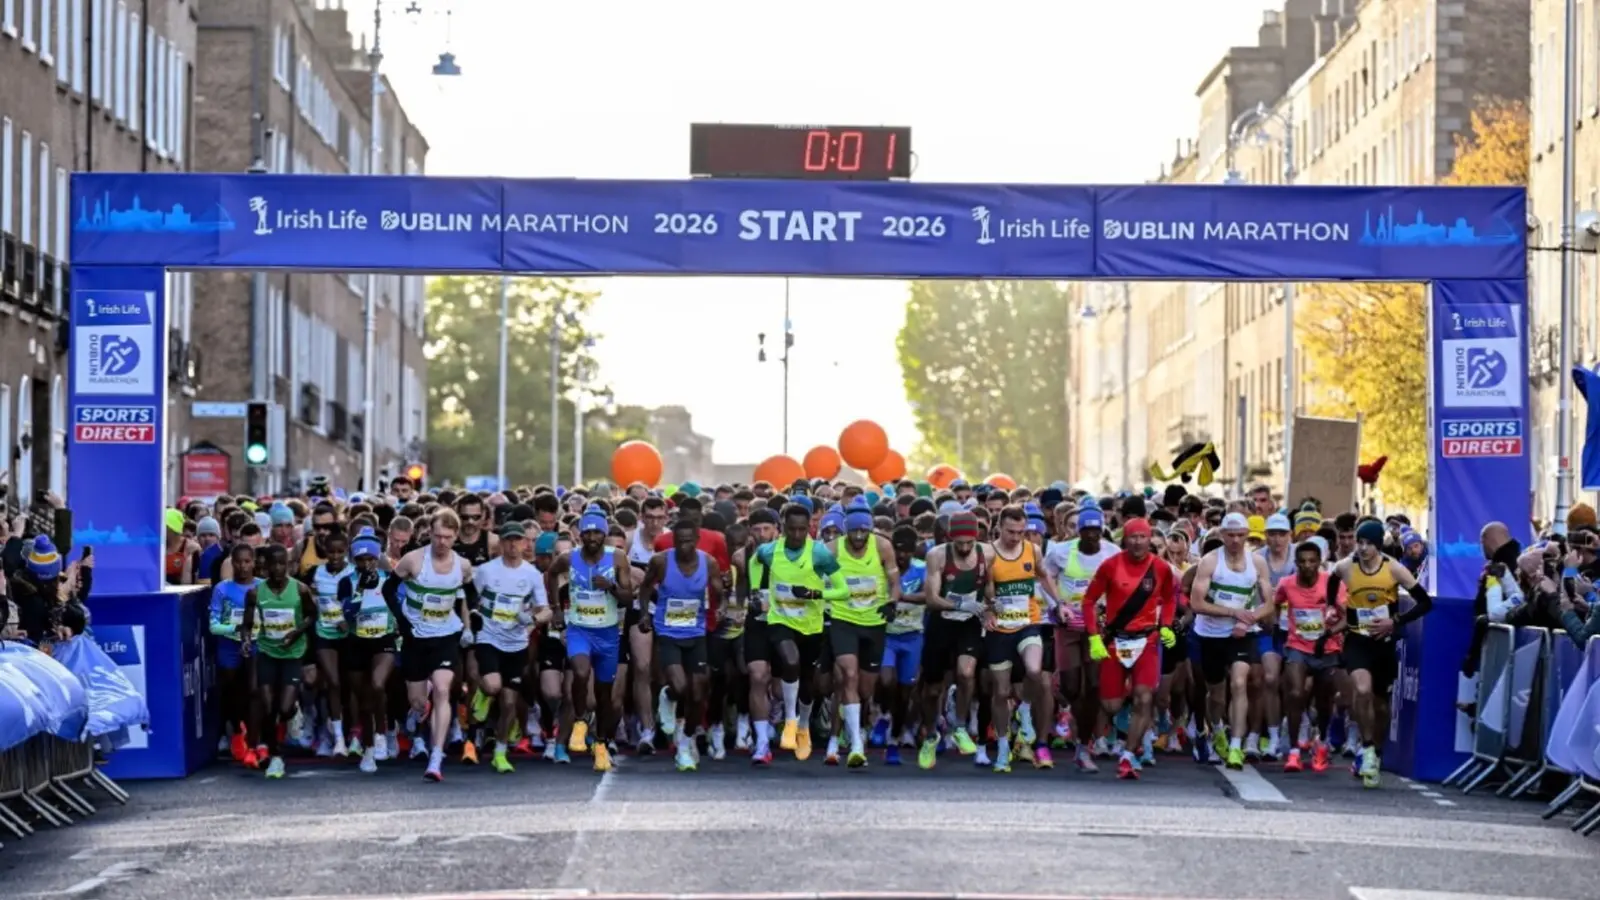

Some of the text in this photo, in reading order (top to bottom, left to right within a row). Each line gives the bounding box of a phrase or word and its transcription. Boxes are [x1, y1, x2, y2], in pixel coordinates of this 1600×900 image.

[805, 131, 896, 171] 0:01
[277, 209, 368, 230] Irish Life
[381, 210, 628, 233] DUBLIN MARATHON
[654, 210, 946, 241] 2026 START 2026
[1000, 218, 1091, 238] Irish Life
[1104, 219, 1349, 241] DUBLIN MARATHON
[98, 304, 141, 314] Irish Life
[1464, 316, 1507, 328] Irish Life
[89, 334, 99, 376] DUBLIN
[1456, 347, 1466, 389] DUBLIN
[81, 408, 150, 422] SPORTS
[81, 426, 149, 440] DIRECT
[1448, 422, 1516, 436] SPORTS
[1448, 440, 1516, 454] DIRECT
[104, 642, 127, 653] Life
